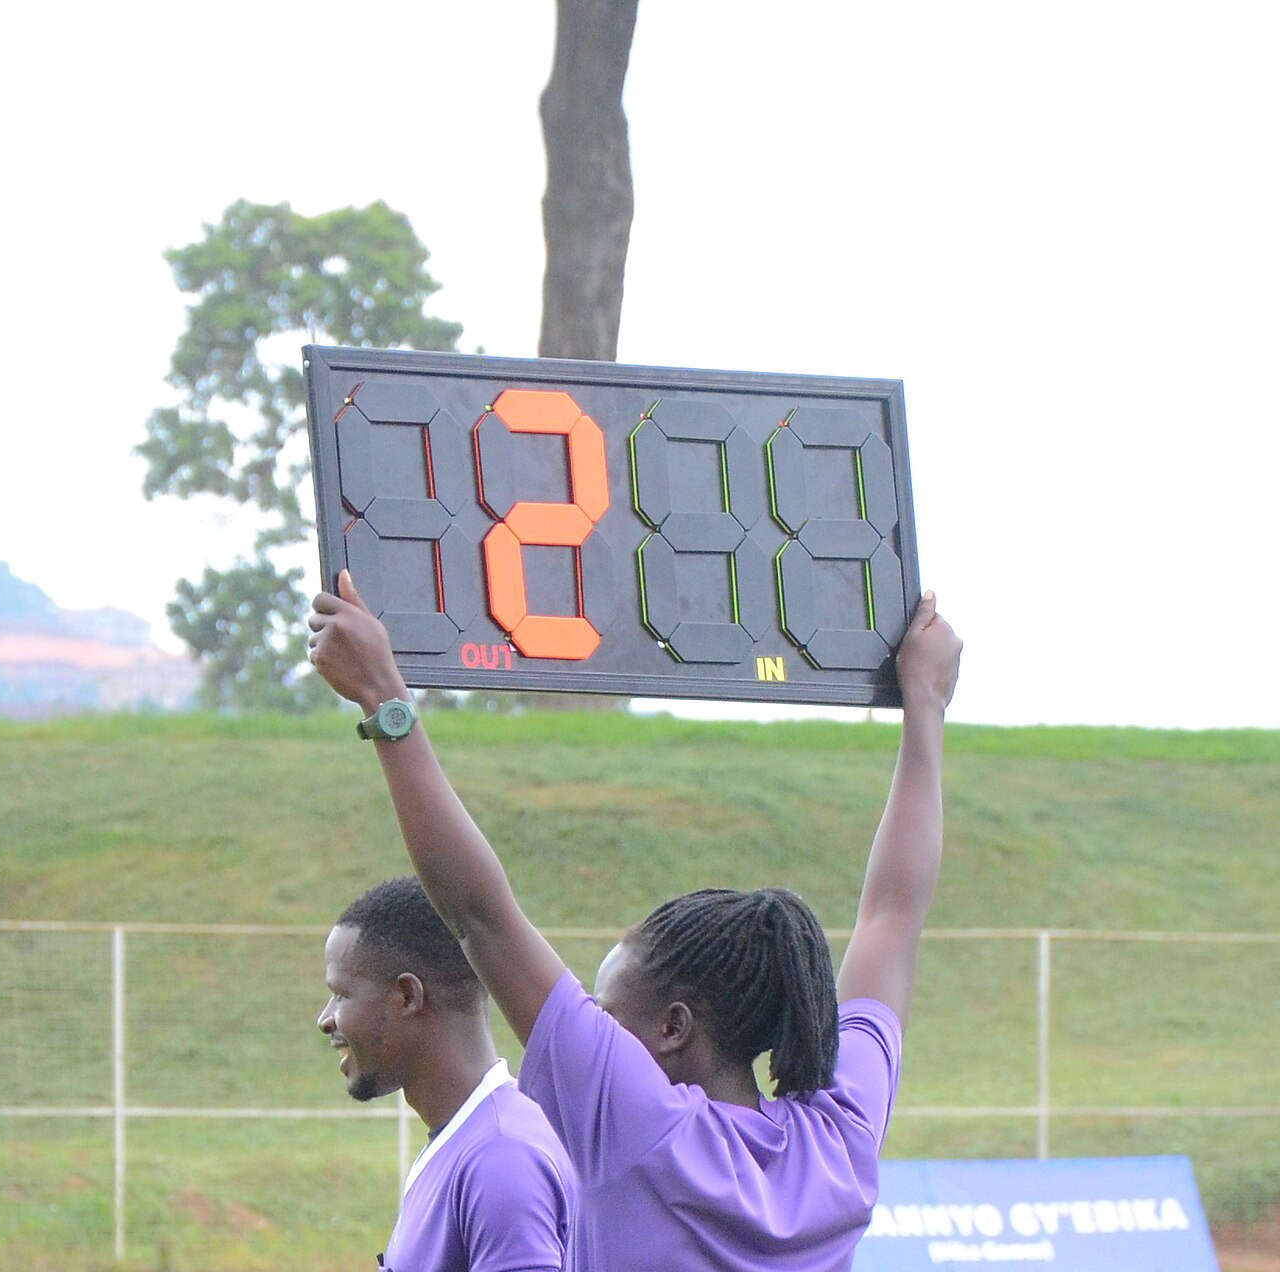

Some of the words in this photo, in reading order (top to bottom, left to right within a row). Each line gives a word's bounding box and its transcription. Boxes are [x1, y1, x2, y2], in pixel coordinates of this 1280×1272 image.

[483, 389, 610, 660] 2
[461, 642, 513, 670] OUT
[756, 656, 785, 682] IN
[862, 1204, 1004, 1237] ANNYO
